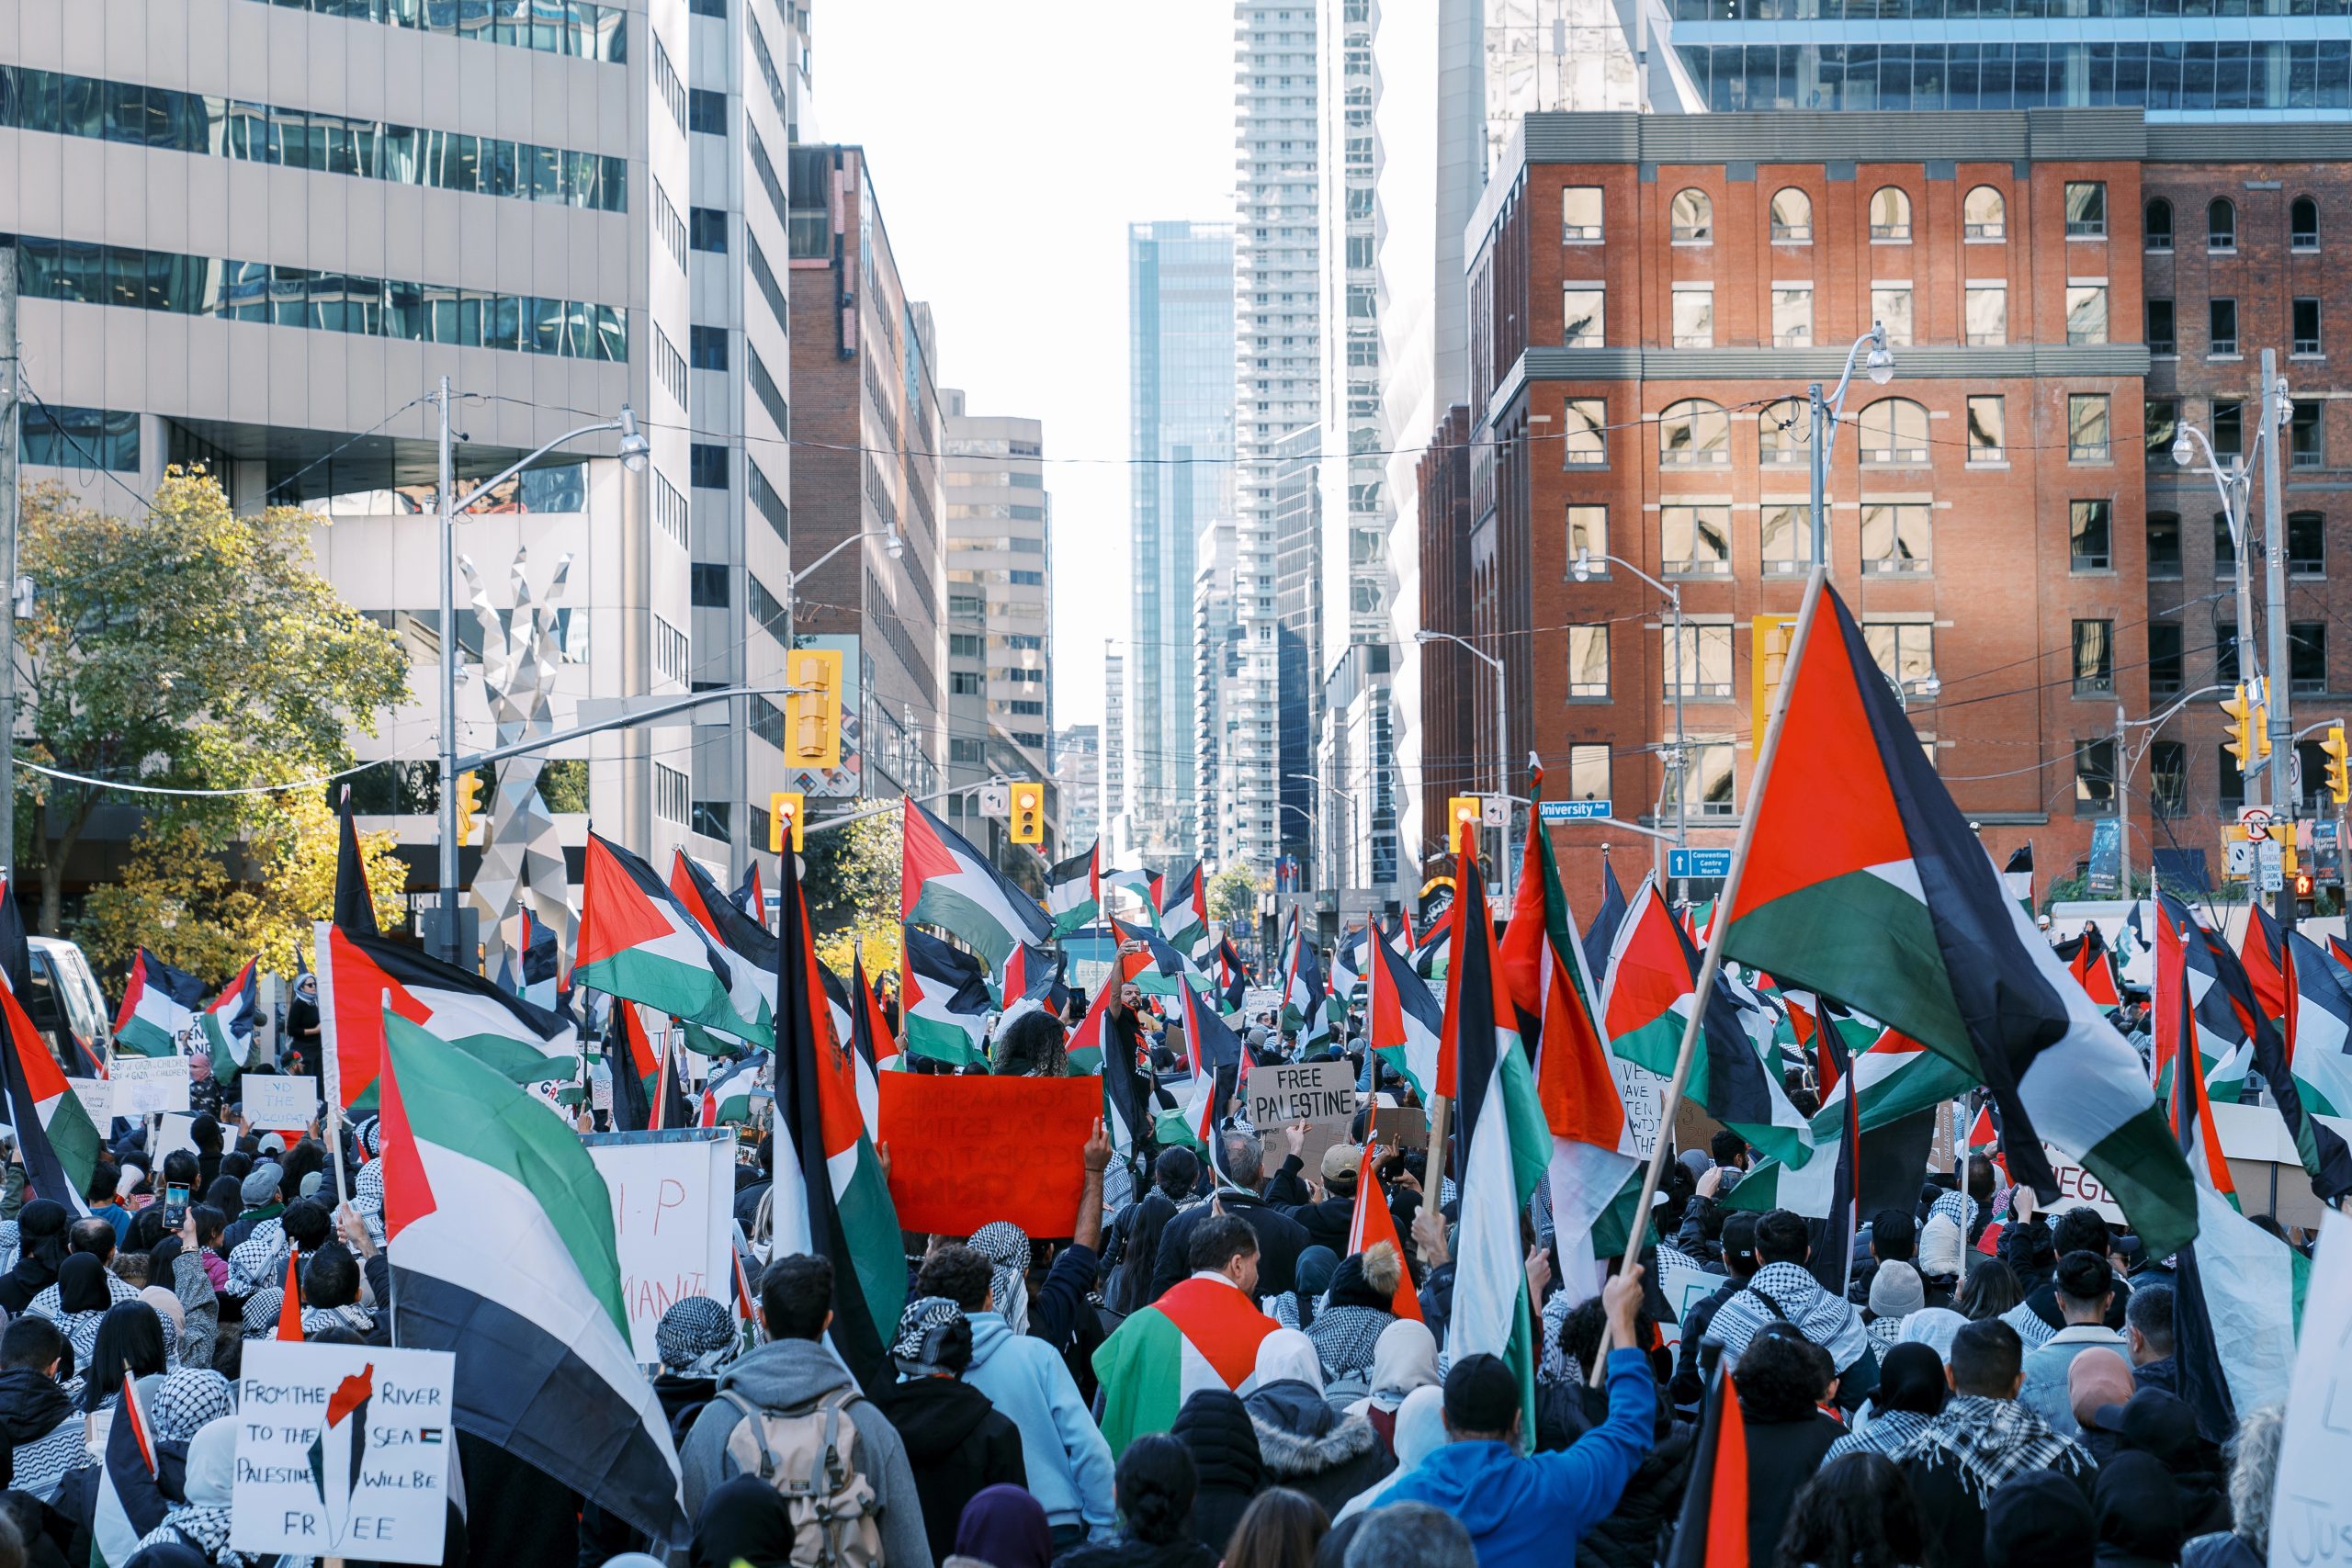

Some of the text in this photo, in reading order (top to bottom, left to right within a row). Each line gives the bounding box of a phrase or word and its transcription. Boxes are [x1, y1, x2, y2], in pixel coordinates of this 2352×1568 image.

[1540, 803, 1593, 818] University
[1277, 1067, 1323, 1090] FREE
[264, 1094, 295, 1107] THE
[1256, 1089, 1352, 1123] PALESTINE
[1943, 1116, 1951, 1161] COLLECTION
[244, 1379, 443, 1407] FROM THE RIVER
[246, 1424, 414, 1450] TO THE SEA
[236, 1456, 438, 1490] PALESTINE WILL BE
